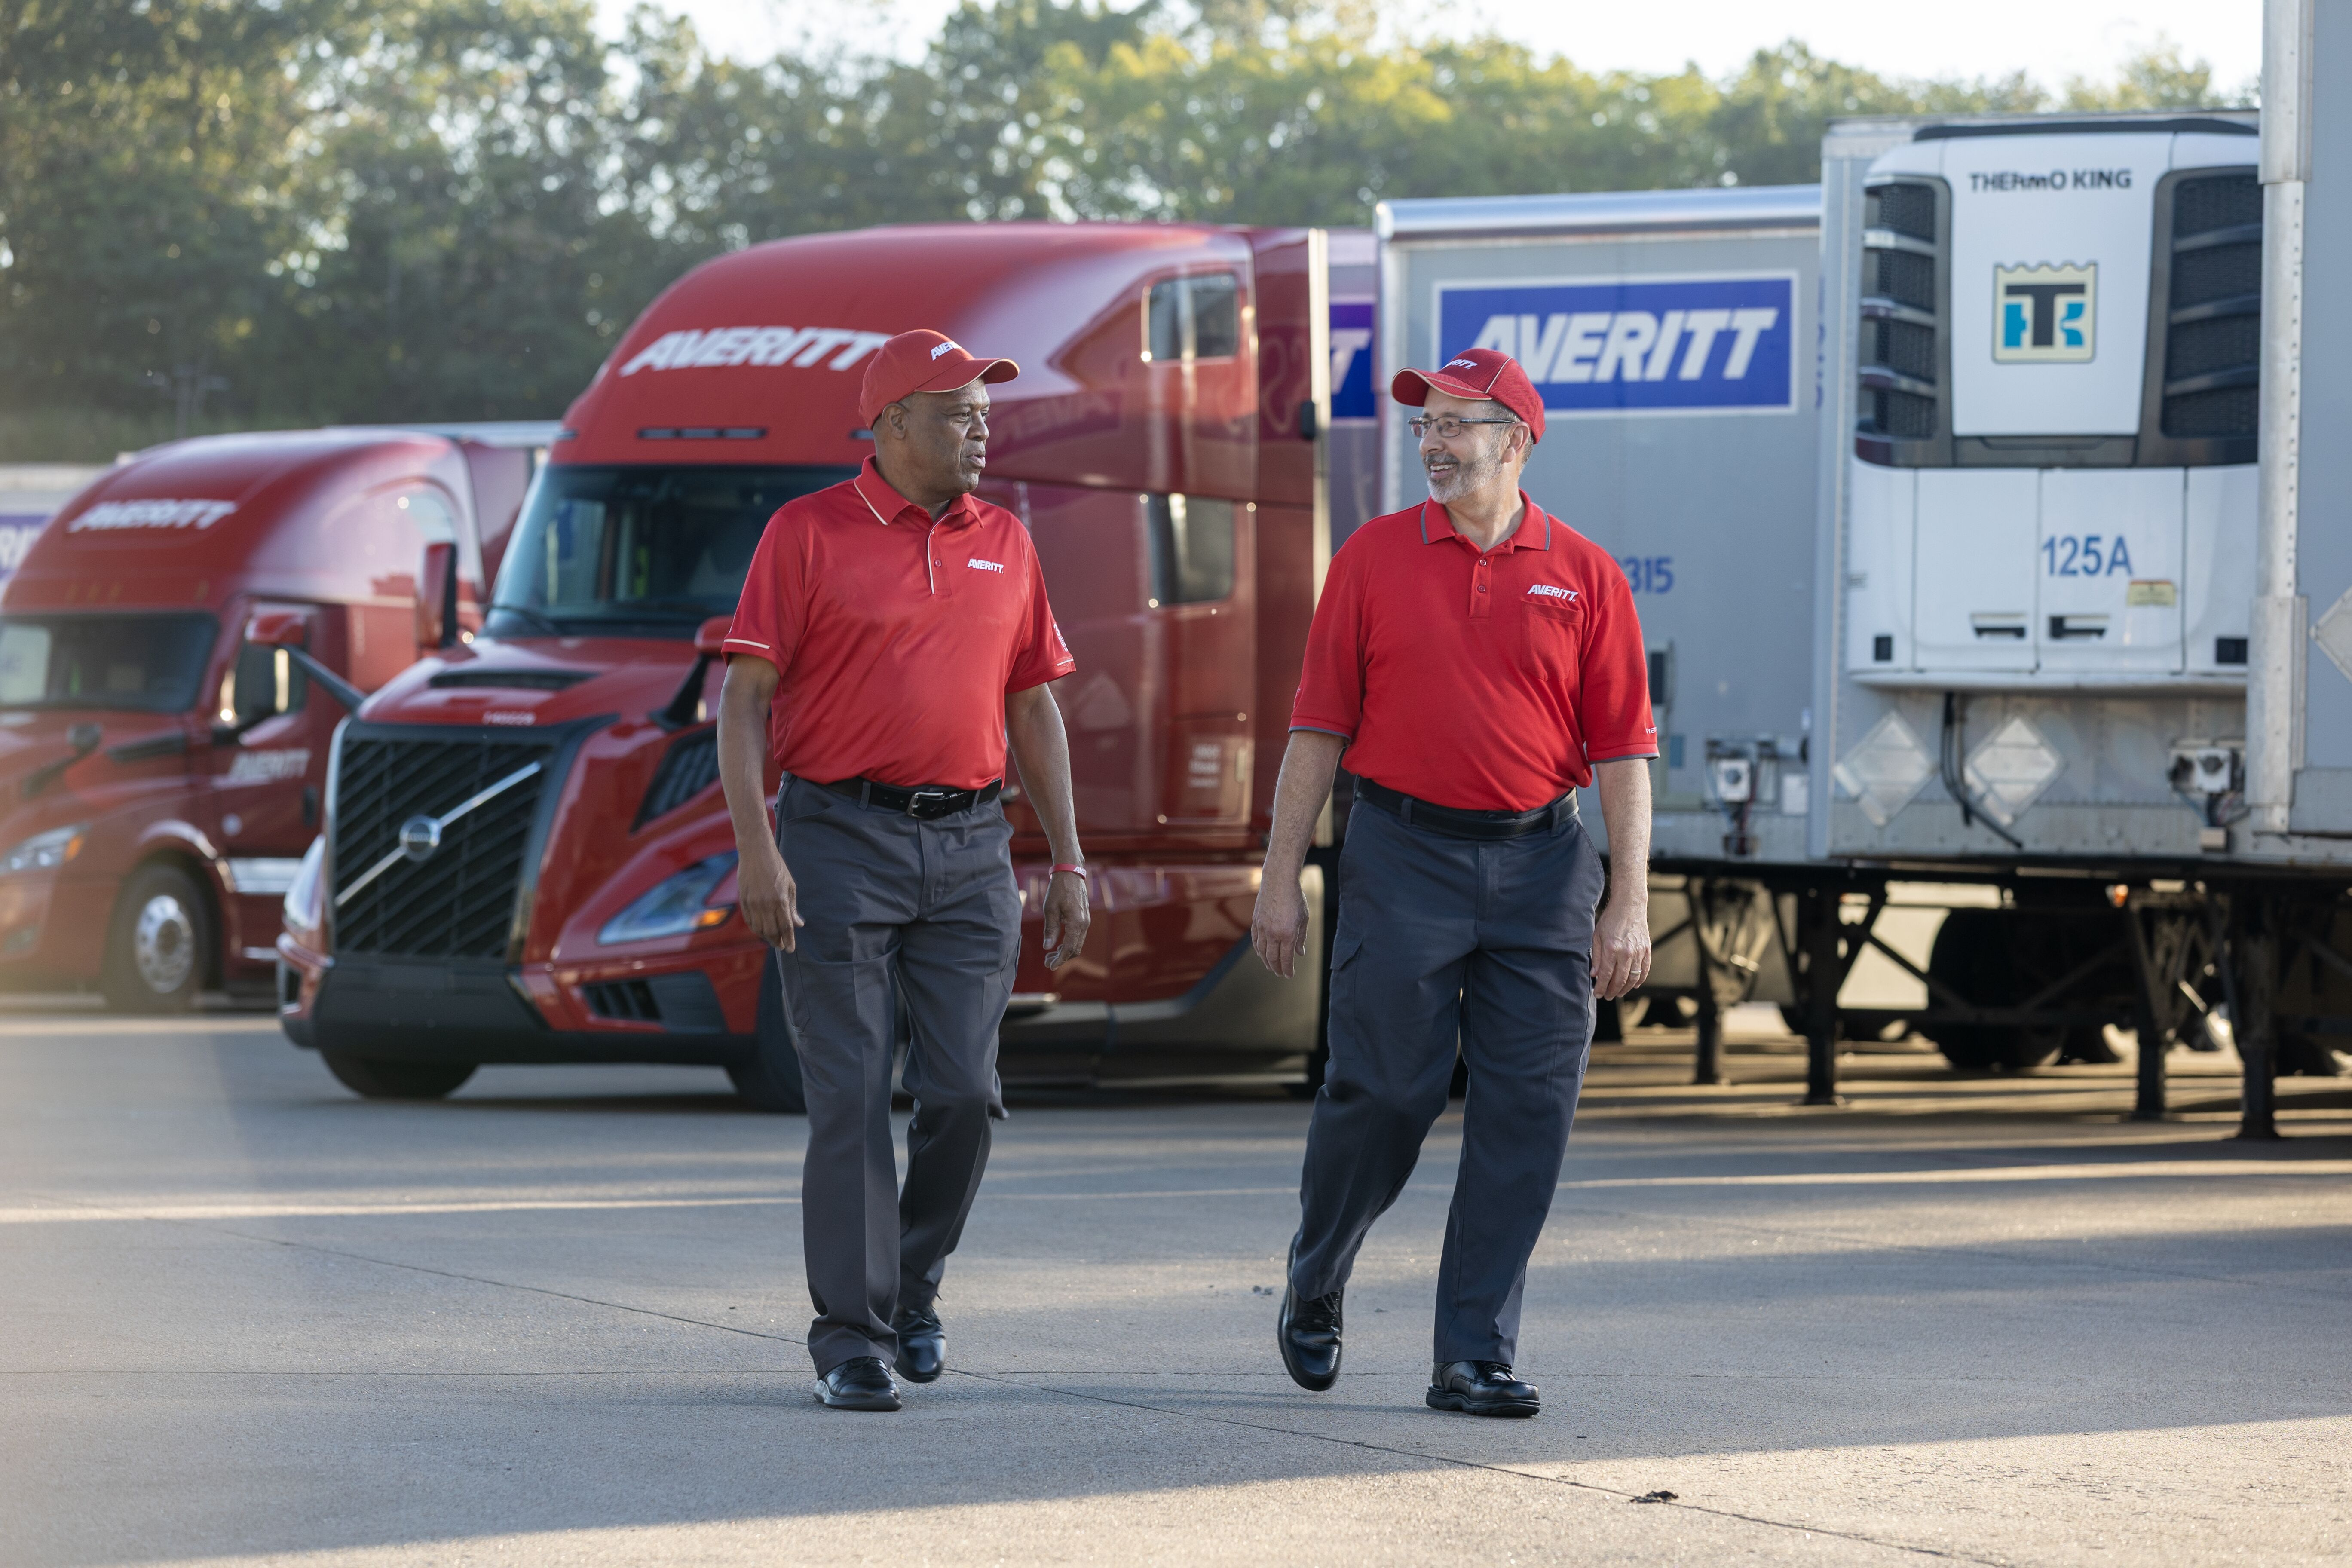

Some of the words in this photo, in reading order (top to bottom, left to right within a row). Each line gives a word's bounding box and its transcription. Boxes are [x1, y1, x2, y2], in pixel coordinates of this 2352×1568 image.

[2073, 168, 2132, 190] KING
[618, 326, 896, 378] AVERITT
[1616, 556, 1674, 593] 315
[2042, 536, 2133, 576] 125A
